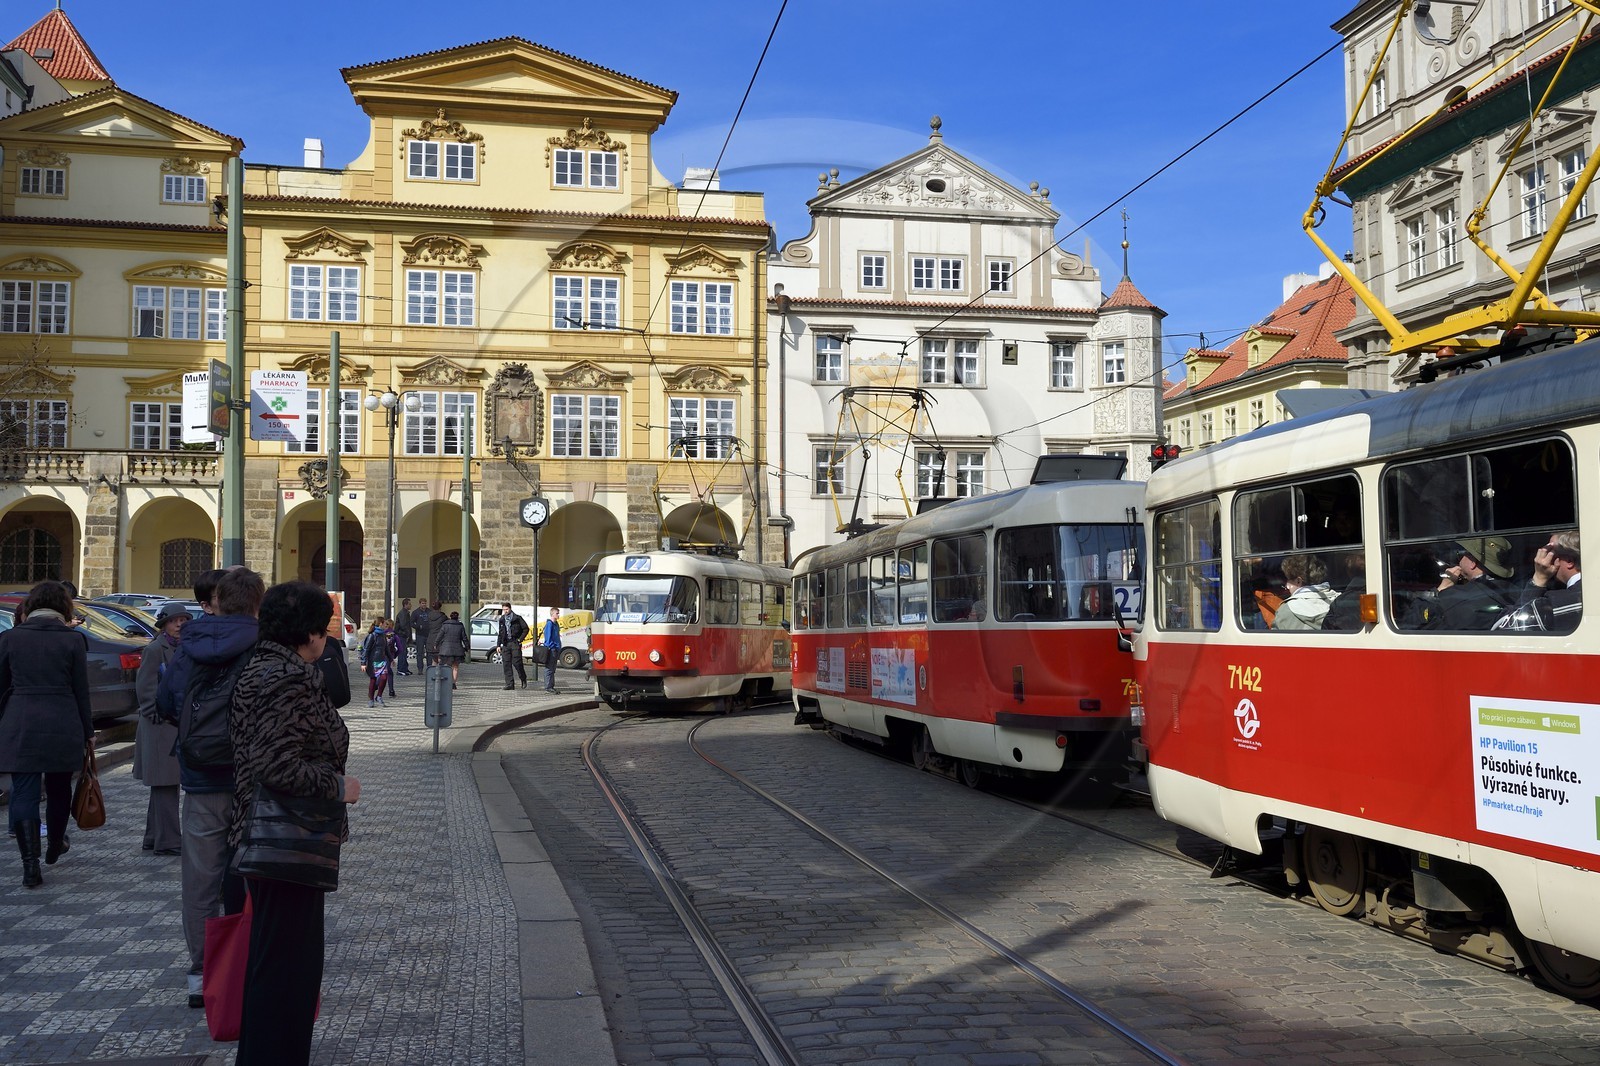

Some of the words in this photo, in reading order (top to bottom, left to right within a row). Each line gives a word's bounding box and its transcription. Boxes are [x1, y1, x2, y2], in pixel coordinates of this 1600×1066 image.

[628, 558, 650, 571] 22
[615, 651, 637, 661] 7070
[1228, 664, 1262, 692] 7142
[1121, 679, 1137, 695] 7
[1481, 713, 1490, 721] Pro
[1490, 713, 1503, 723] práci
[1507, 716, 1516, 724] pro
[1551, 719, 1577, 729] Windows
[1480, 736, 1491, 749] HP
[1492, 738, 1526, 753] Pavilion
[1527, 742, 1538, 755] 15
[1481, 755, 1533, 777] Působivé
[1535, 762, 1582, 785] funkce.
[1482, 774, 1528, 797] Výrazné
[1530, 781, 1570, 806] barvy.
[1482, 797, 1543, 818] HPmarket.cz/hraje
